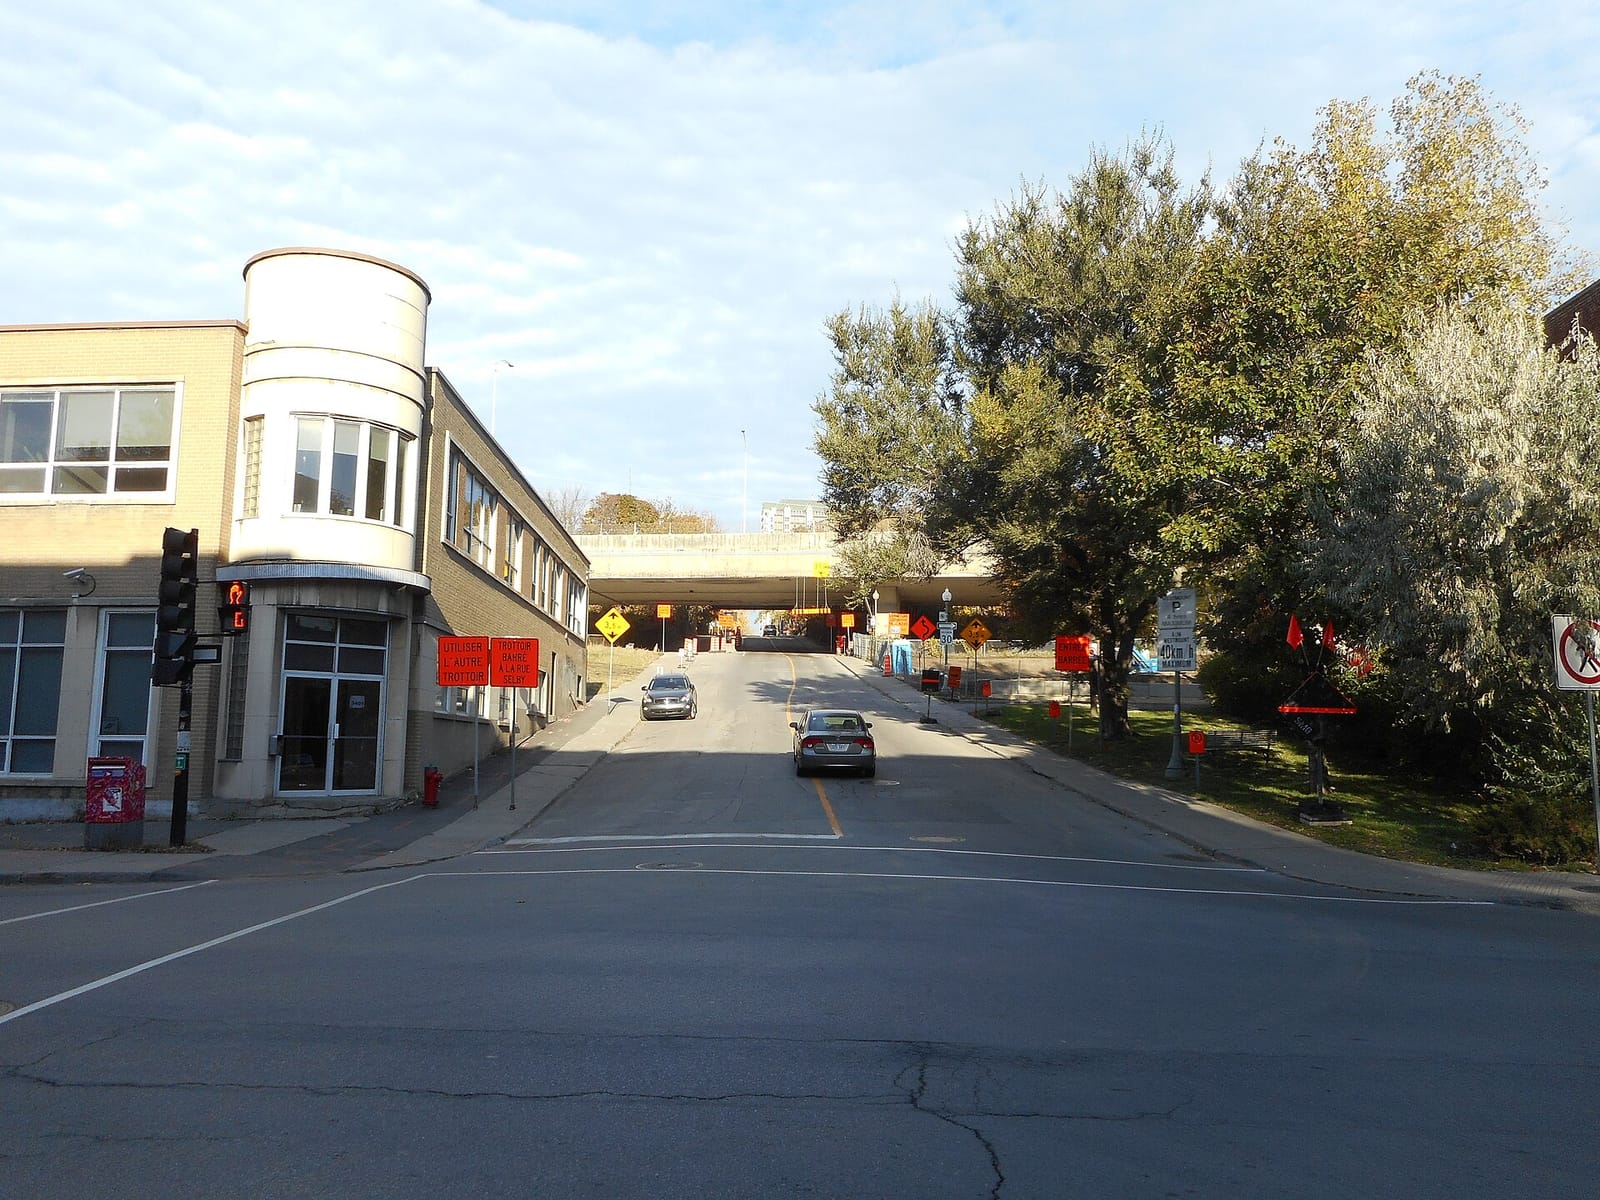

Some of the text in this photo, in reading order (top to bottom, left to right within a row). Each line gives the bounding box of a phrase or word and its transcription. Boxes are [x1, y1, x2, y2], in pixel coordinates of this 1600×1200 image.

[941, 634, 952, 644] 30
[443, 642, 483, 653] UTILISER
[498, 641, 532, 651] TROTTOIR
[516, 664, 530, 674] RUE
[442, 671, 484, 682] TROTTOIR
[503, 674, 526, 684] SELBY
